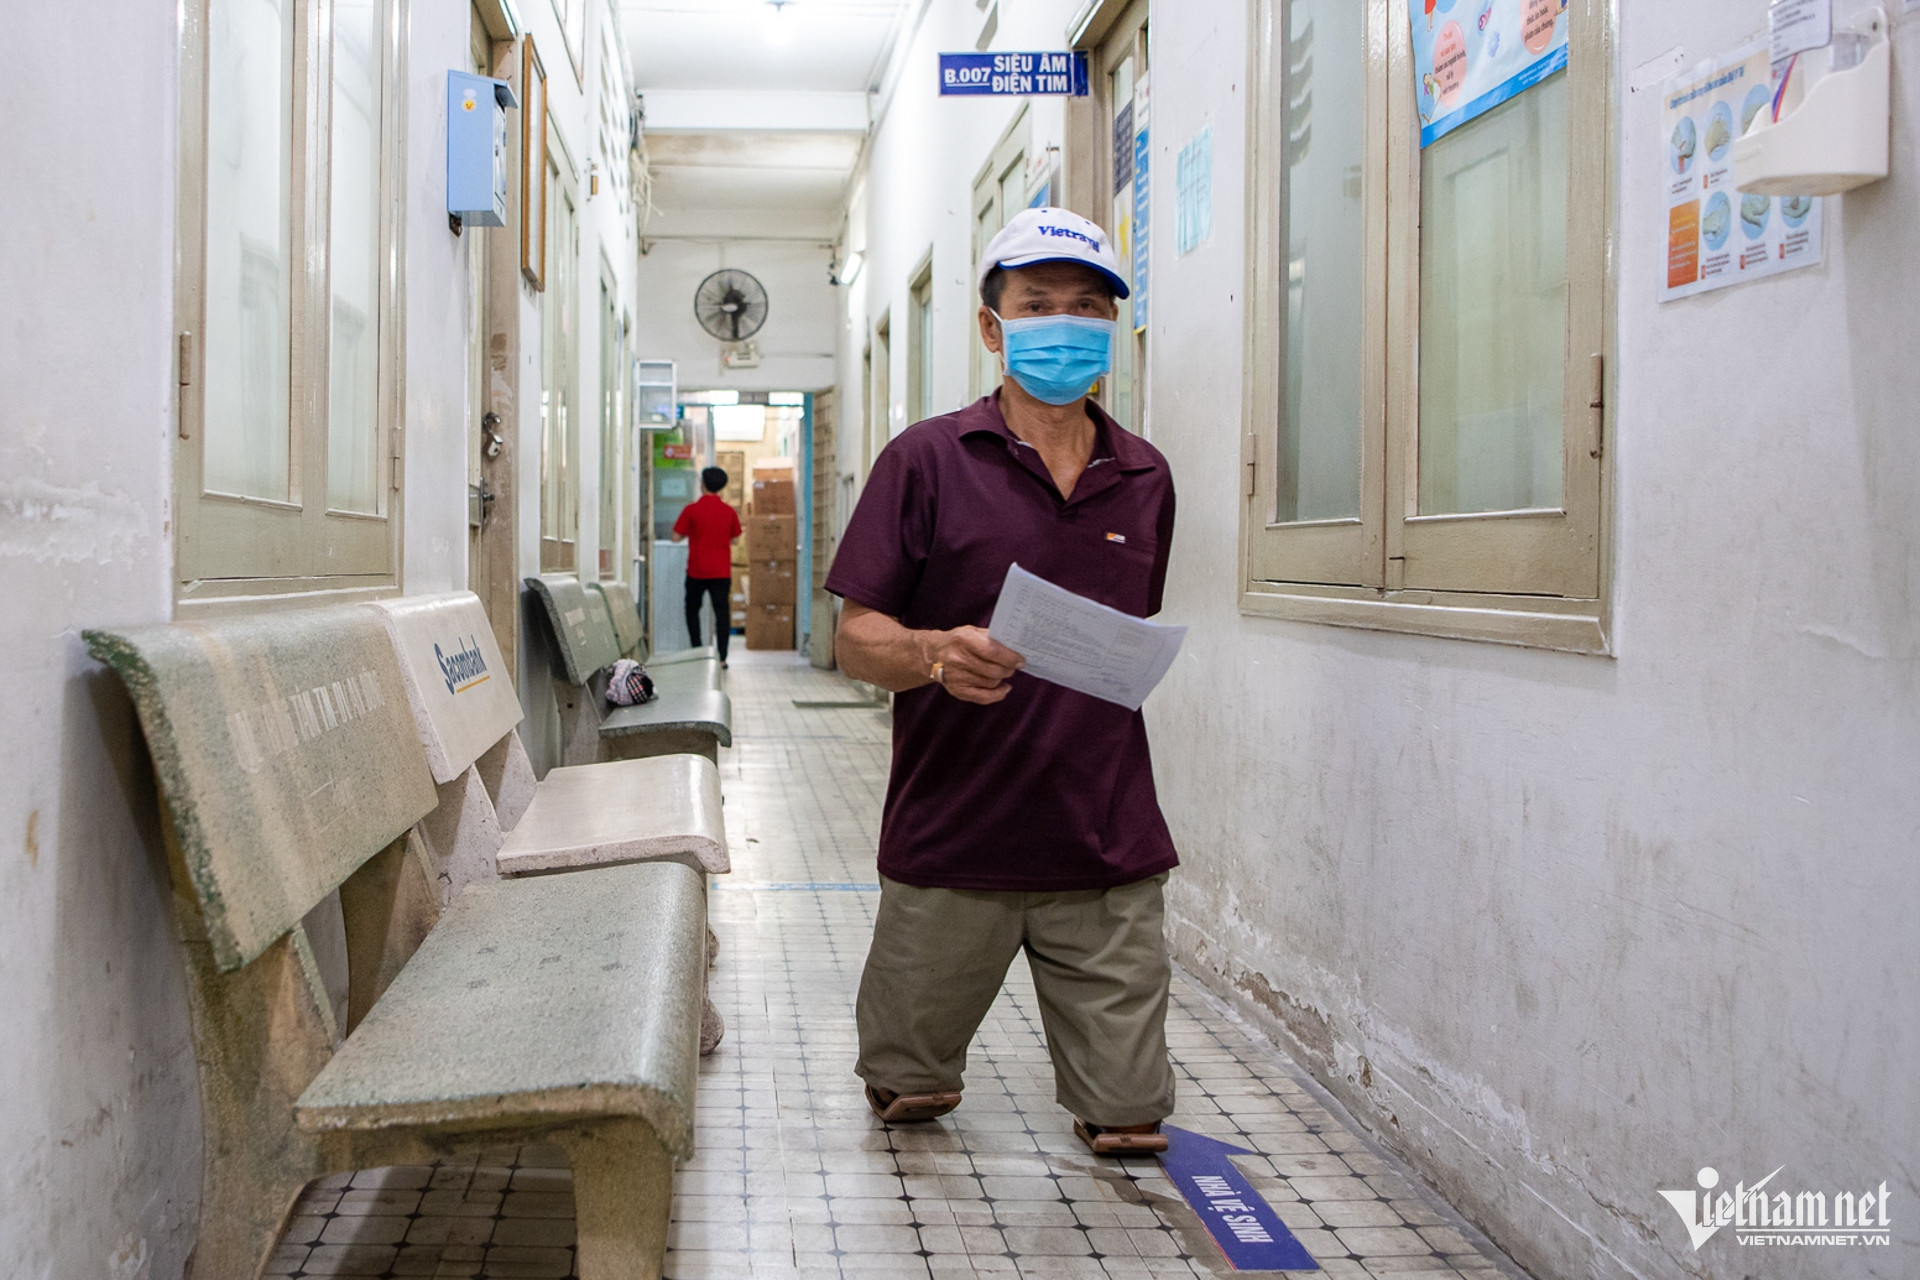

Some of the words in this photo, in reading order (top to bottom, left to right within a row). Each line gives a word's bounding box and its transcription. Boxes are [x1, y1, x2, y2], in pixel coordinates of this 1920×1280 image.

[993, 53, 1033, 73] SIÊU
[1039, 53, 1067, 73] ÂM
[944, 67, 991, 84] B.007
[992, 72, 1032, 95] ĐIỆN
[1036, 75, 1067, 92] TIM
[434, 634, 487, 695] Sacombank
[1191, 1175, 1241, 1197] NHÀ
[1208, 1198, 1255, 1213] VỆ
[1222, 1214, 1274, 1243] SINH
